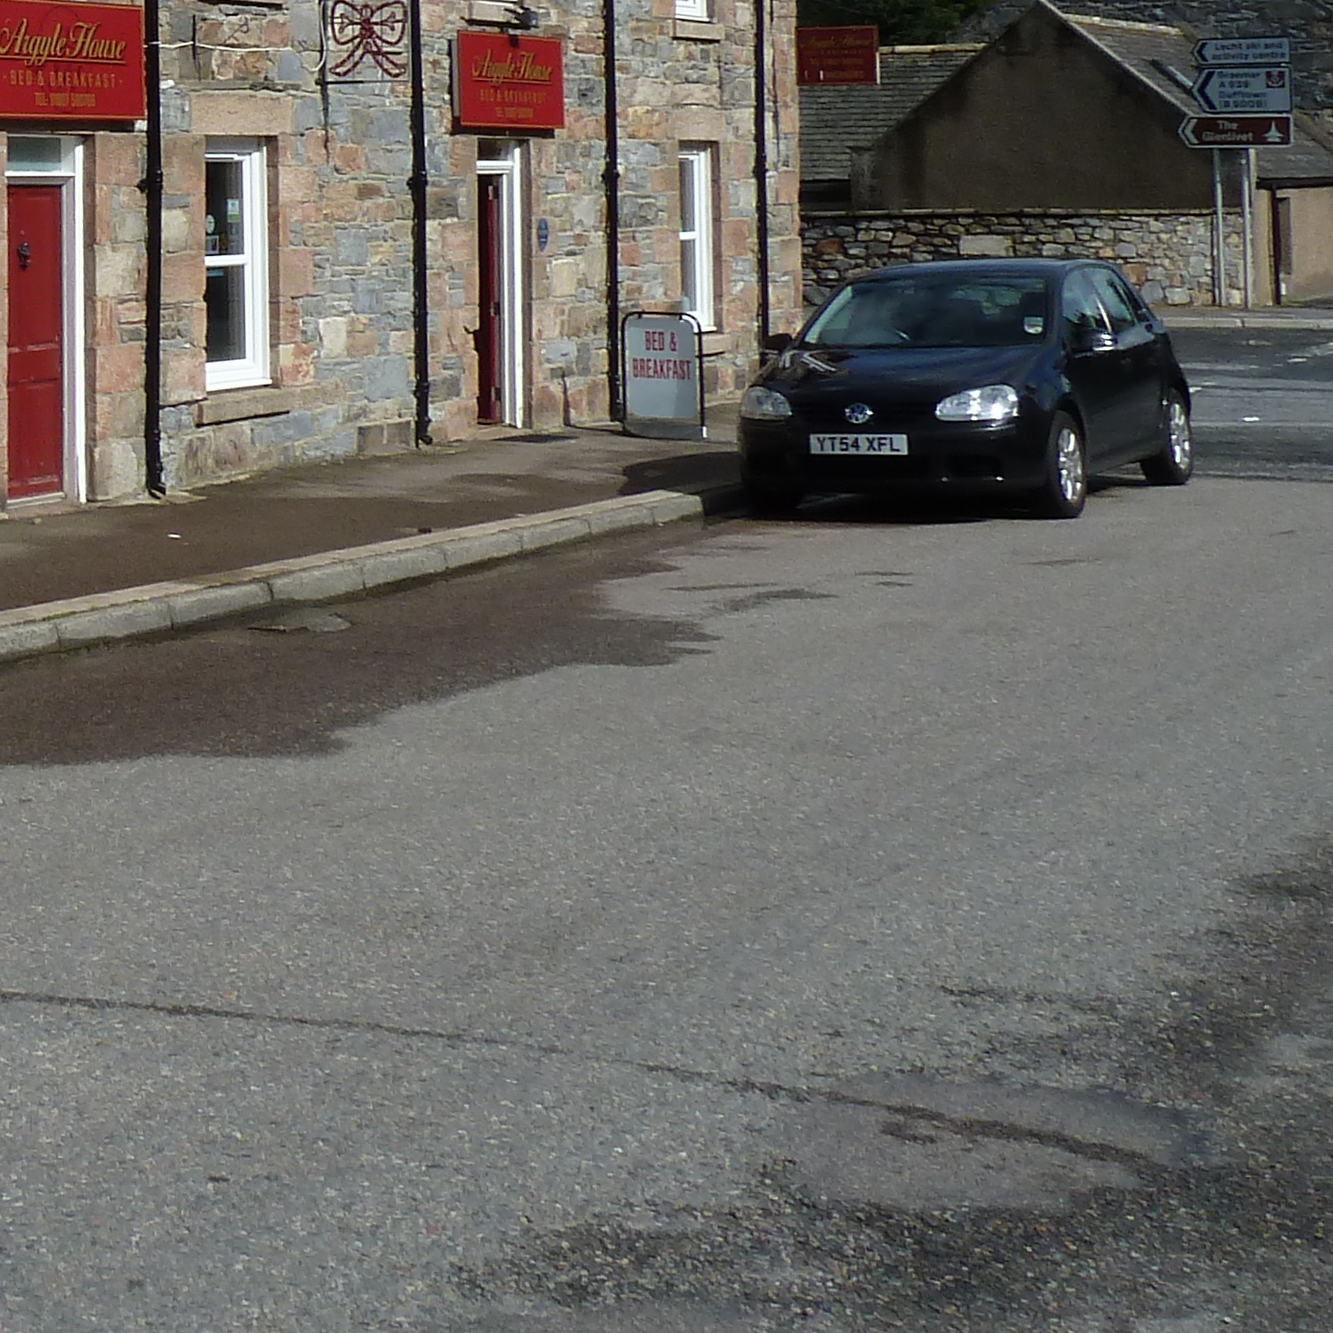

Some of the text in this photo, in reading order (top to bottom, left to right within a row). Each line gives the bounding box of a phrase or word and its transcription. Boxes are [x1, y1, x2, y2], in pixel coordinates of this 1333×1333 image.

[66, 21, 126, 60] House
[1264, 42, 1283, 50] and
[472, 49, 552, 84] Argyle House
[9, 69, 116, 89] BED & BREAKFAST
[1218, 120, 1238, 129] The
[645, 331, 677, 352] BED &
[633, 358, 691, 380] BREAKFAST
[816, 437, 900, 452] YT54 XFL
